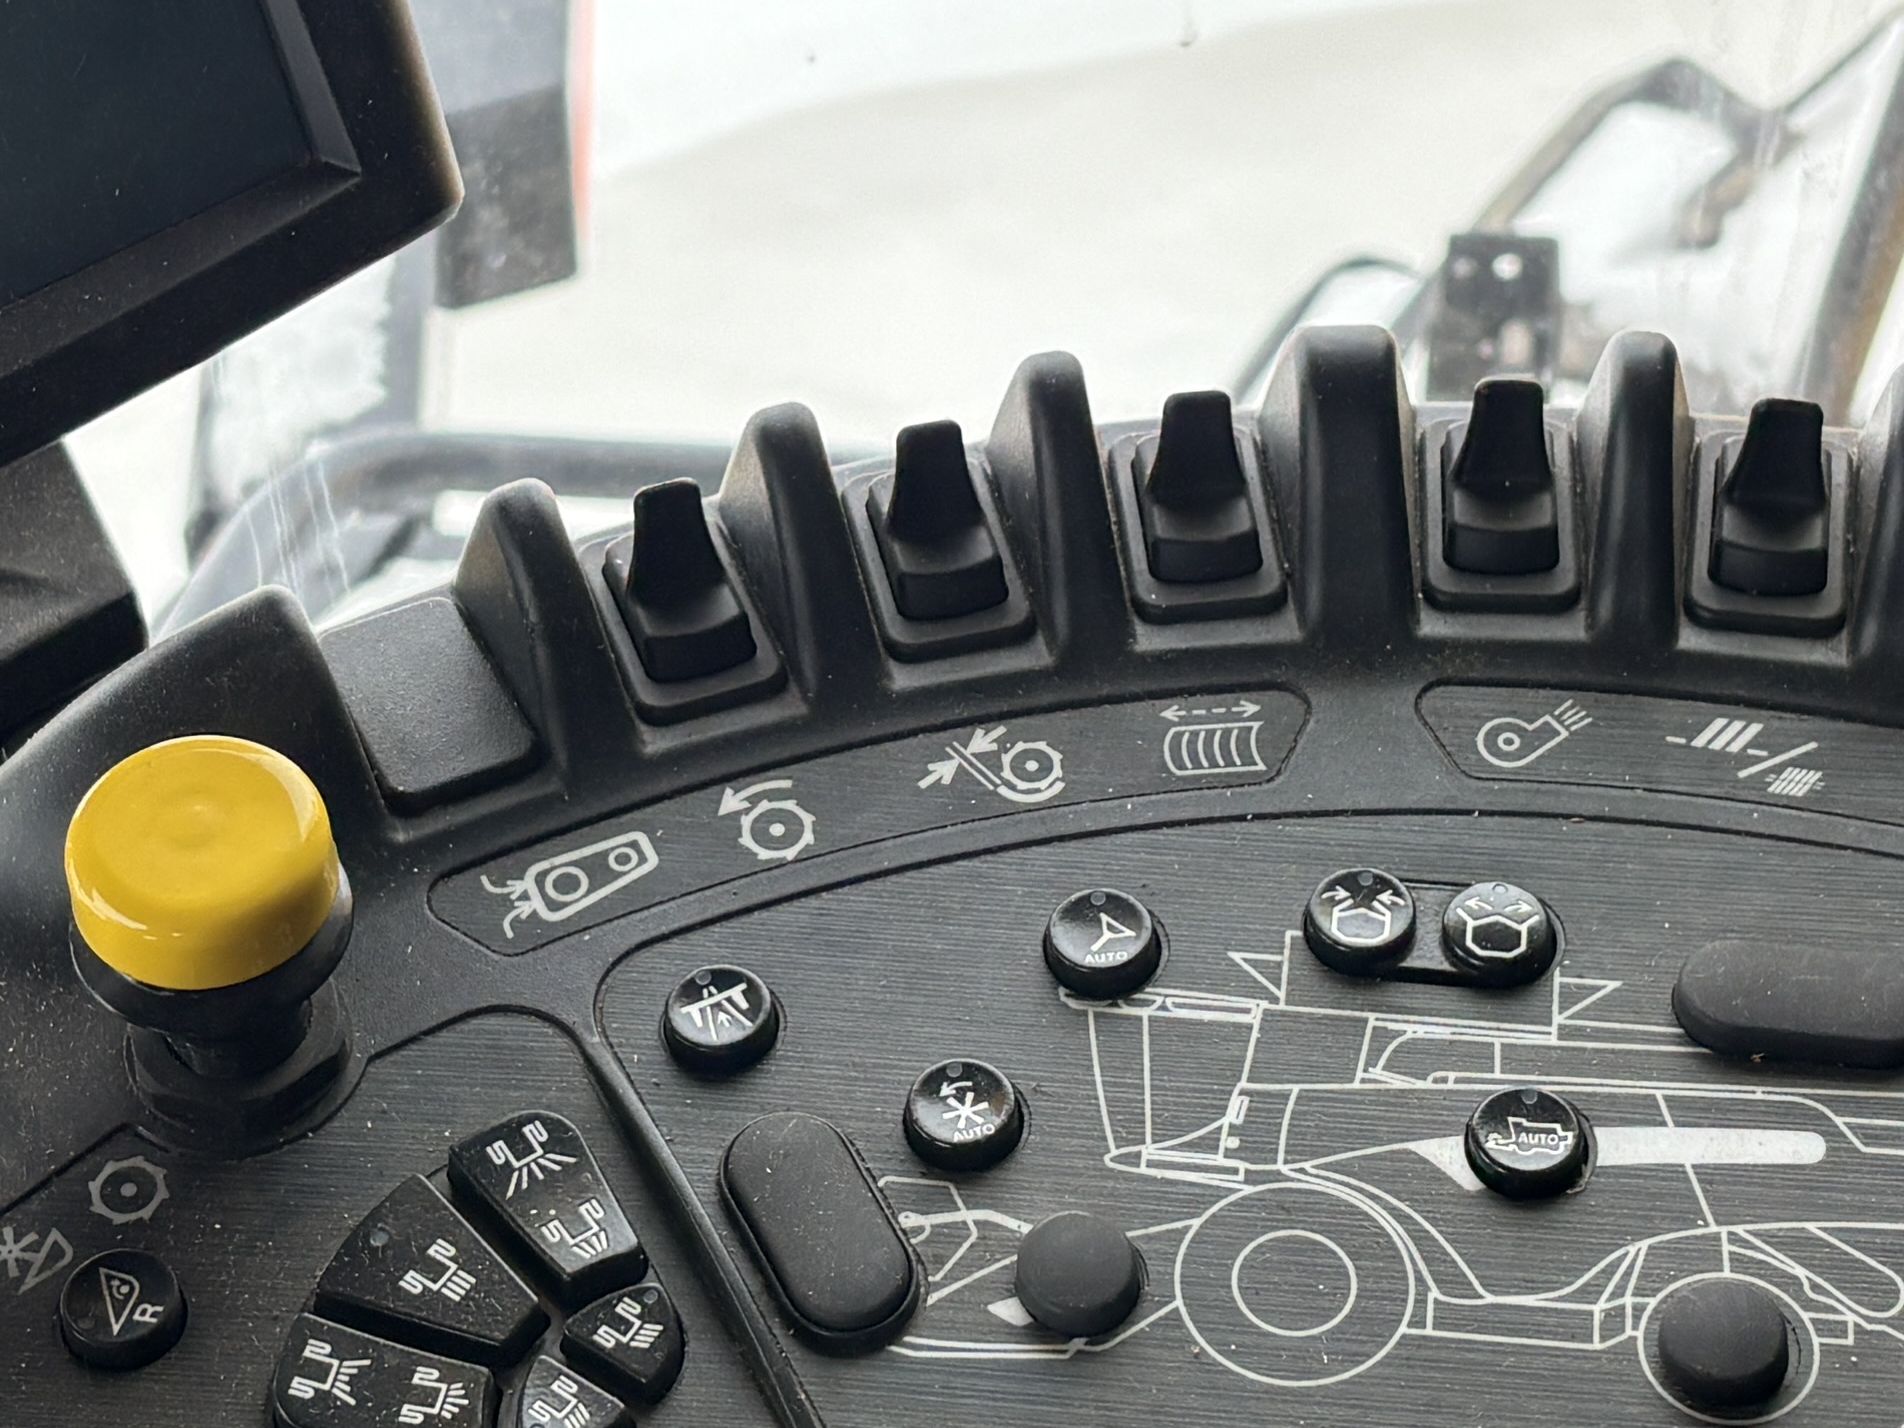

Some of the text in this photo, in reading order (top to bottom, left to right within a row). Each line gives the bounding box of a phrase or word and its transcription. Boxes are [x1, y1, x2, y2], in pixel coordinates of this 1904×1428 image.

[1084, 950, 1129, 965] AUTO
[952, 1122, 996, 1143] AUTO
[1517, 1131, 1560, 1146] AUTO
[132, 1302, 165, 1324] R
